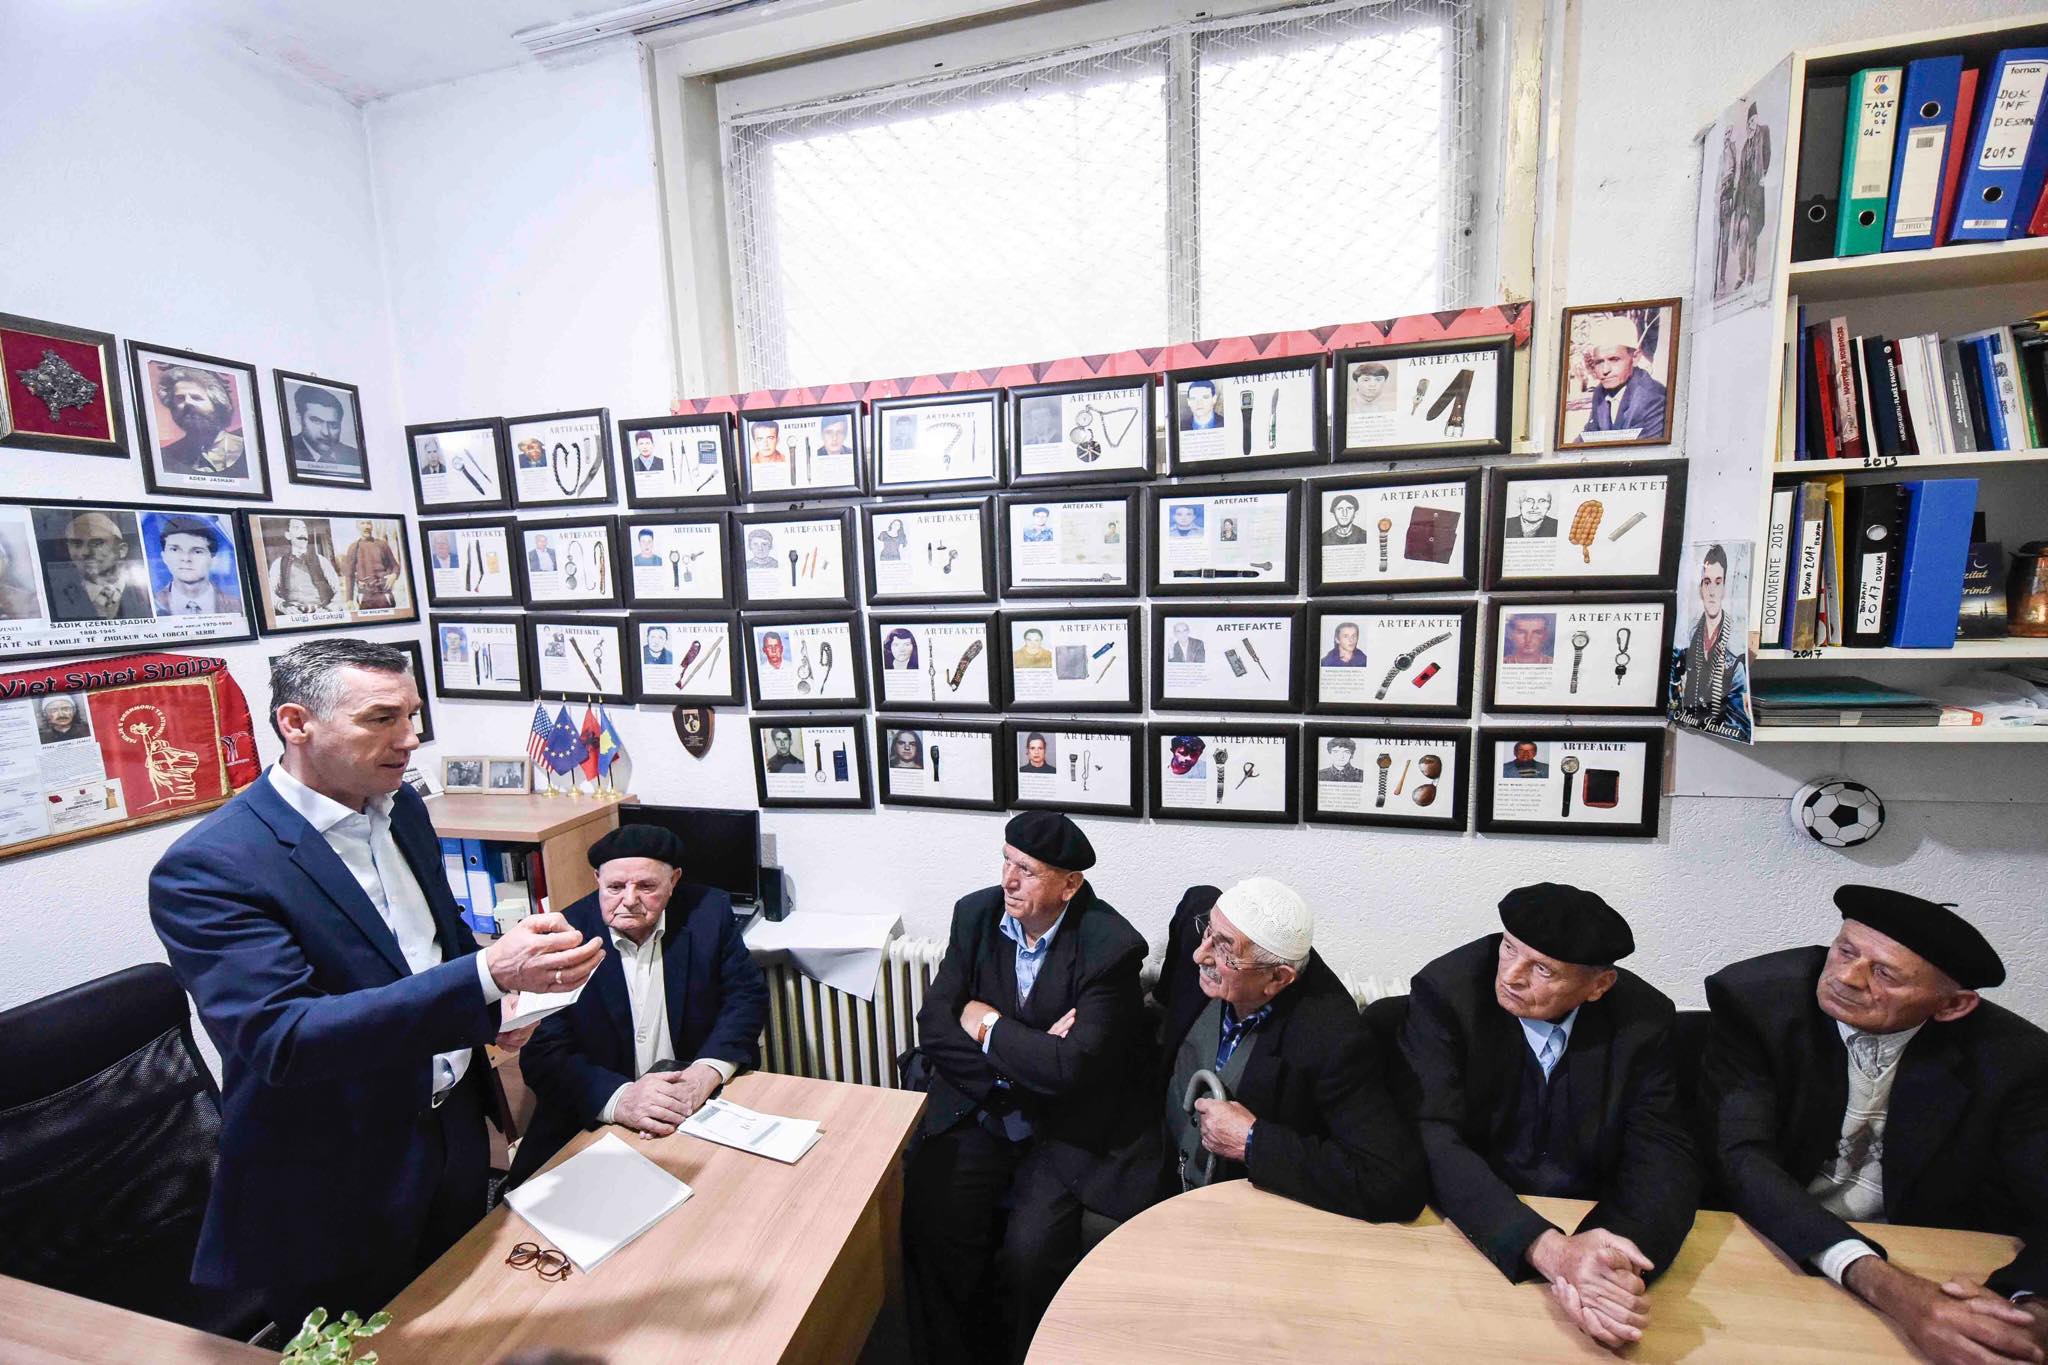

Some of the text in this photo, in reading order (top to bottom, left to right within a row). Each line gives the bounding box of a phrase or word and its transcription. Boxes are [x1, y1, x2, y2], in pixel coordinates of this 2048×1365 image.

[2010, 66, 2041, 74] fornax
[1864, 100, 1895, 110] TAXE
[1984, 146, 2016, 160] 2015
[1409, 351, 1497, 366] ARTEFAKTET
[1233, 370, 1313, 384] ARTEFAKTET
[1070, 389, 1142, 402] ARTEFAKTET
[1863, 456, 1898, 467] 2013
[1572, 481, 1666, 494] ARTEFAKTET
[1380, 487, 1465, 501] ARTEFAKTET
[1214, 497, 1258, 505] ARTEFAKTE
[917, 513, 979, 524] ARTEFAKTET
[1803, 546, 1815, 570] 2017
[1764, 558, 1781, 625] DOKUMENTE
[1865, 585, 1881, 627] 2017
[1568, 612, 1662, 622] ARTEFAKTET
[1059, 623, 1128, 633] ARTEFAKTET
[1216, 622, 1282, 632] ARTEFAKTE
[1378, 619, 1461, 629] ARTEFAKTET
[794, 627, 850, 636] ARTEFAKTET
[924, 626, 986, 636] ARTEFAKTET
[49, 637, 80, 646] FAMILJE
[103, 633, 139, 642] ZHDUKUR
[162, 630, 188, 638] FORCAT
[1793, 650, 1822, 659] 2017
[65, 667, 137, 689] Shtet
[1703, 716, 1741, 737] Jashari
[1212, 736, 1287, 745] ARTEFAKTET
[1561, 742, 1627, 752] ARTEFAKTE
